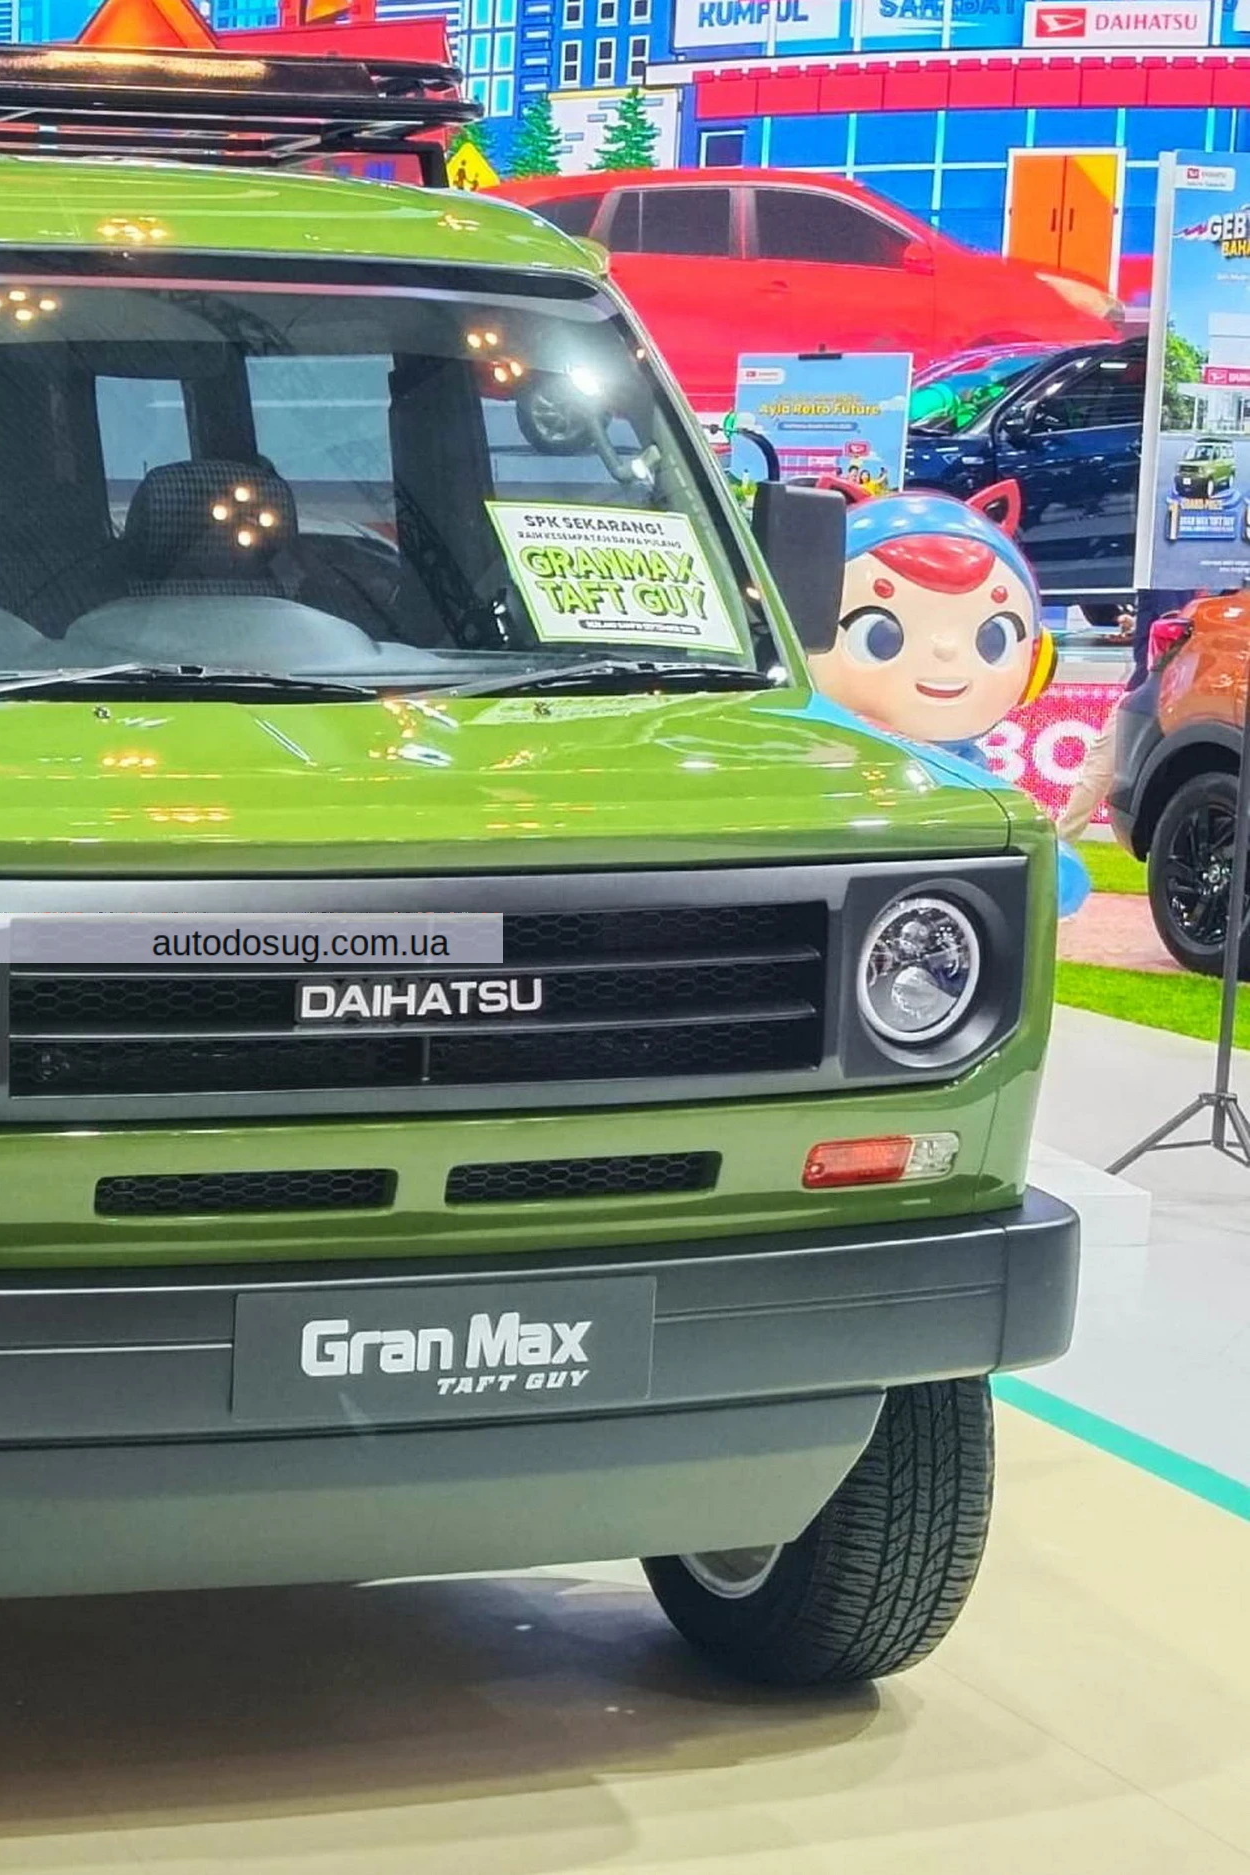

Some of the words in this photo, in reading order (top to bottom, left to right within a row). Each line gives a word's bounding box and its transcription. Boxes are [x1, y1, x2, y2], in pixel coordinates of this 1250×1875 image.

[698, 0, 809, 28] KUMPUL
[1095, 13, 1198, 31] DAIHATSU
[833, 404, 881, 415] Future
[524, 515, 559, 529] SPK
[563, 517, 665, 536] SEKARANG!
[520, 546, 705, 585] GRANMAX
[536, 581, 629, 615] TAFT
[632, 583, 708, 620] GUY
[301, 979, 542, 1018] DAIHATSU
[301, 1319, 453, 1377] Gran
[465, 1312, 592, 1370] Max
[437, 1373, 518, 1396] TAFT
[524, 1369, 591, 1391] GUY
